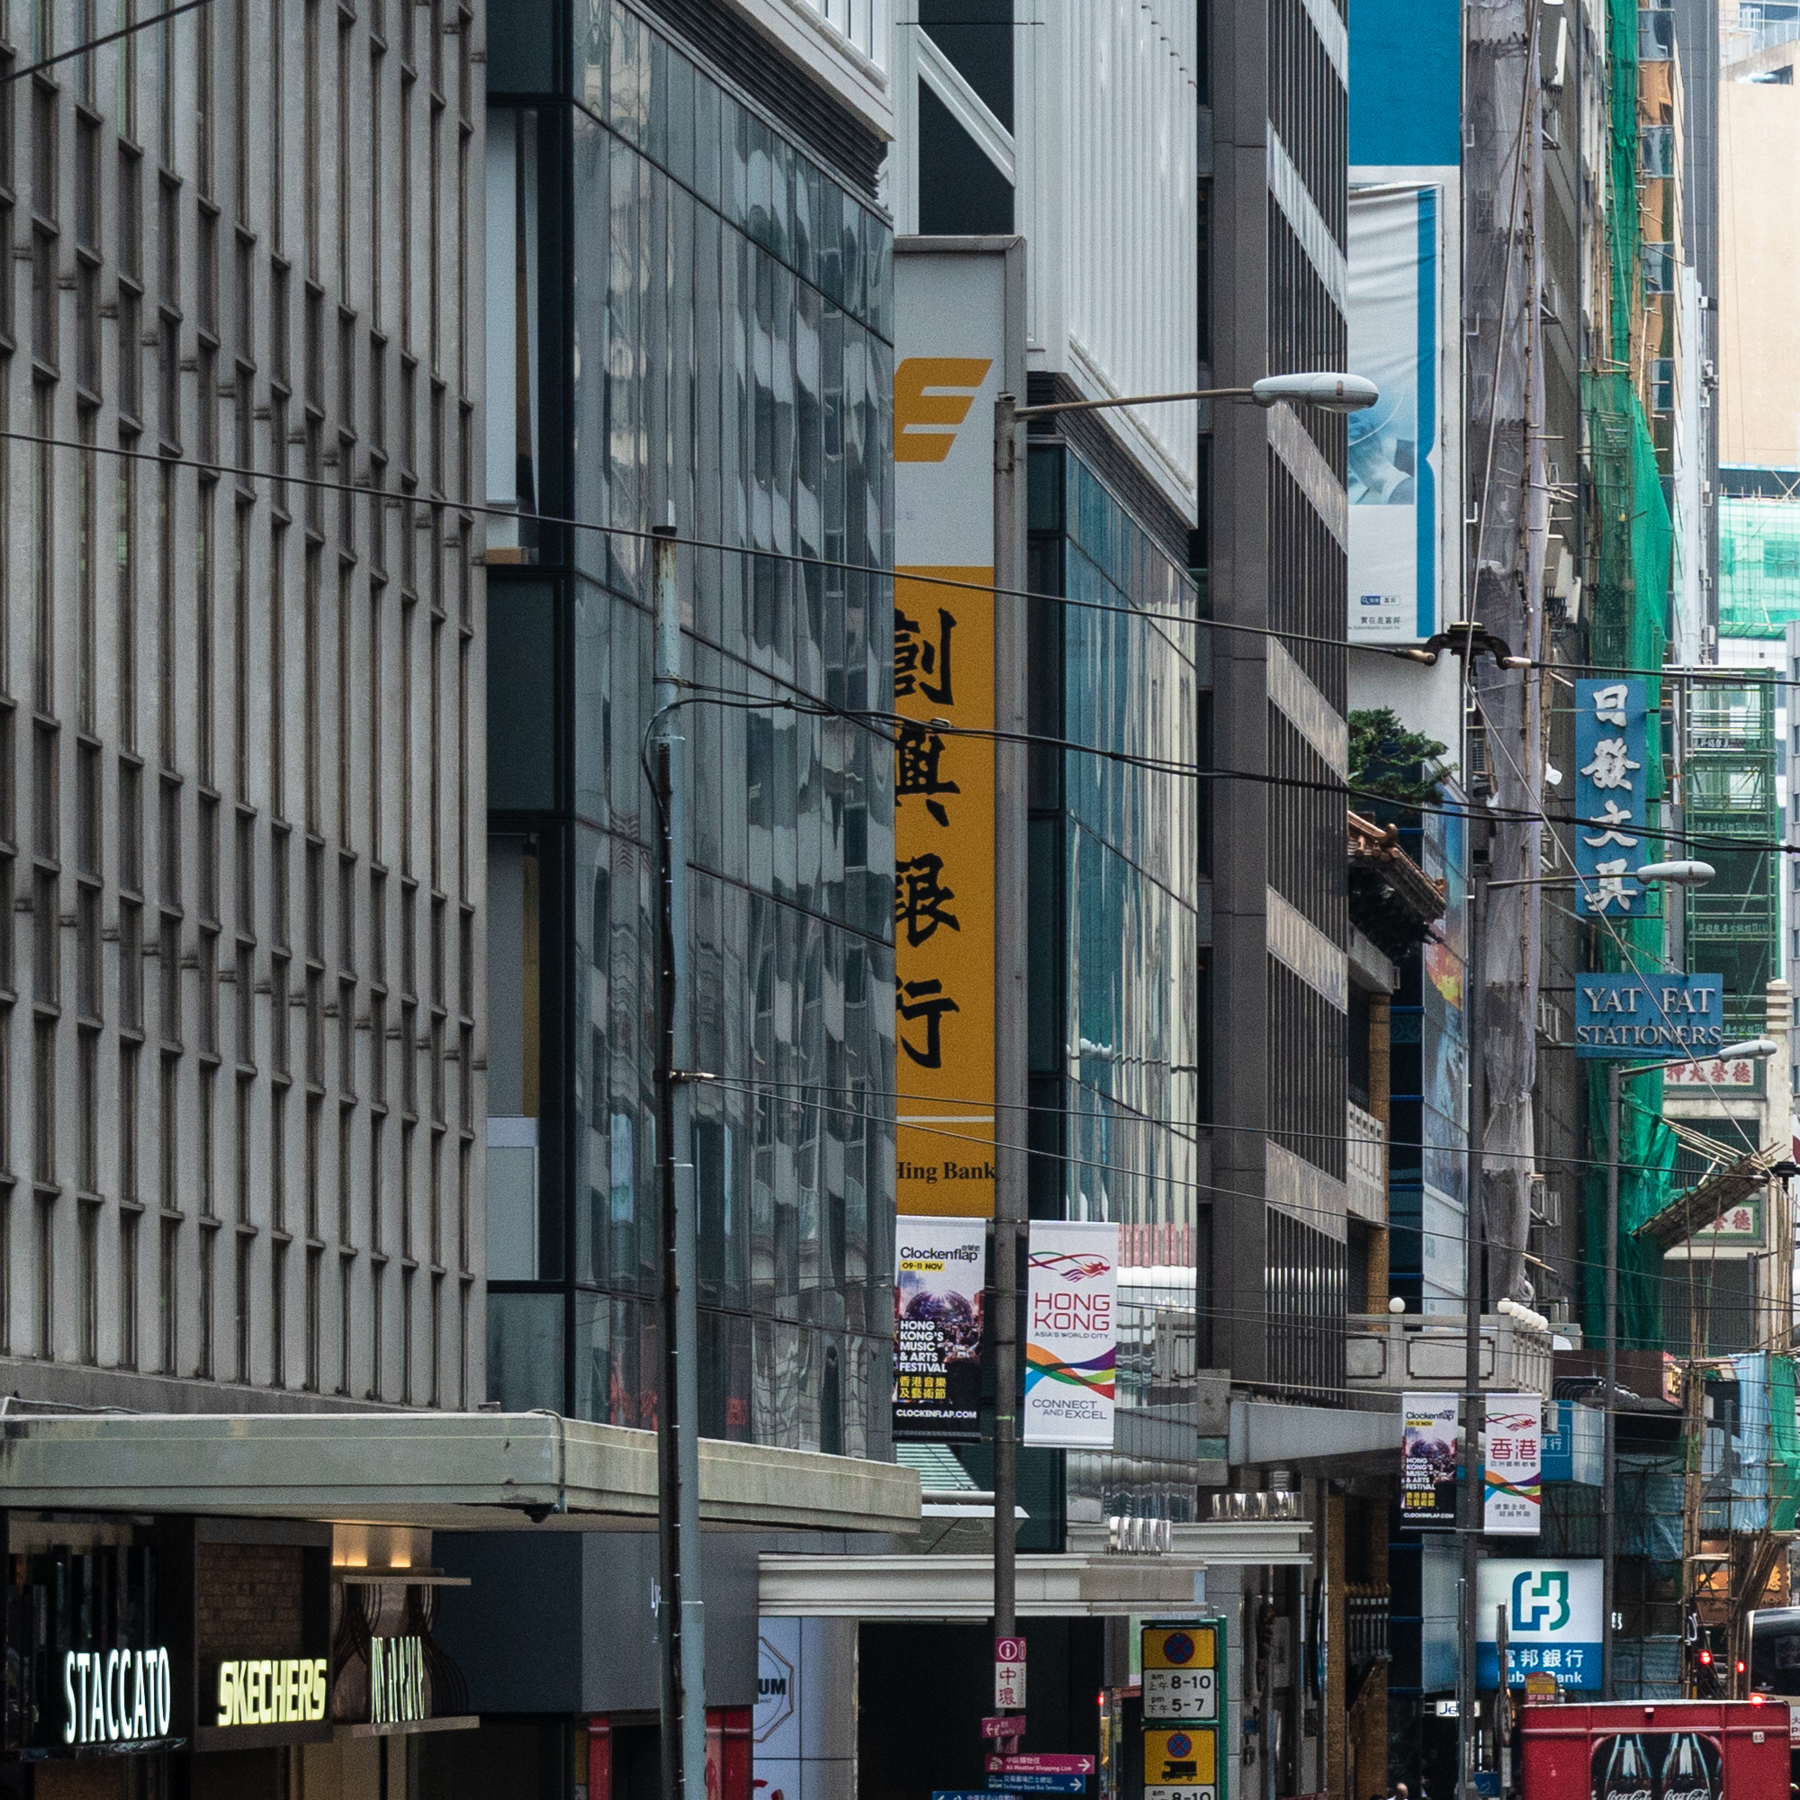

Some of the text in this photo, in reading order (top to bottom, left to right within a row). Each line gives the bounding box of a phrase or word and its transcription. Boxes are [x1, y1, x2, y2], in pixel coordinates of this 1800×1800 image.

[1579, 683, 1641, 913] 日發文具
[1582, 986, 1715, 1015] YAT FAT
[1576, 1025, 1722, 1047] STATIONERS
[943, 1162, 996, 1180] Bank
[900, 1246, 978, 1262] Clockenflap
[924, 1263, 943, 1271] NOV
[1034, 1292, 1110, 1311] HONG
[900, 1321, 935, 1331] HONG
[1034, 1313, 1110, 1331] KONG
[900, 1331, 944, 1342] KONG'S
[900, 1342, 936, 1352] MUSIC
[910, 1352, 938, 1362] ARTS
[899, 1362, 948, 1373] FESTIVAL
[899, 1376, 947, 1388] 香港音樂
[899, 1388, 947, 1400] 及藝術節
[1032, 1399, 1098, 1410] CONNECT
[896, 1409, 977, 1419] CLOCKENFLAP.COM
[1043, 1408, 1108, 1420] AND EXCEL
[1406, 1411, 1454, 1422] Clockenflap
[1490, 1437, 1537, 1461] 香港
[1406, 1483, 1436, 1491] FESTIVAL
[998, 1666, 1017, 1705] 中環
[1151, 1673, 1212, 1690] am 8-10
[63, 1646, 171, 1745] STACCATO
[217, 1658, 328, 1727] SKECHERS
[1171, 1698, 1205, 1713] 5-7
[1152, 1789, 1165, 1797] am
